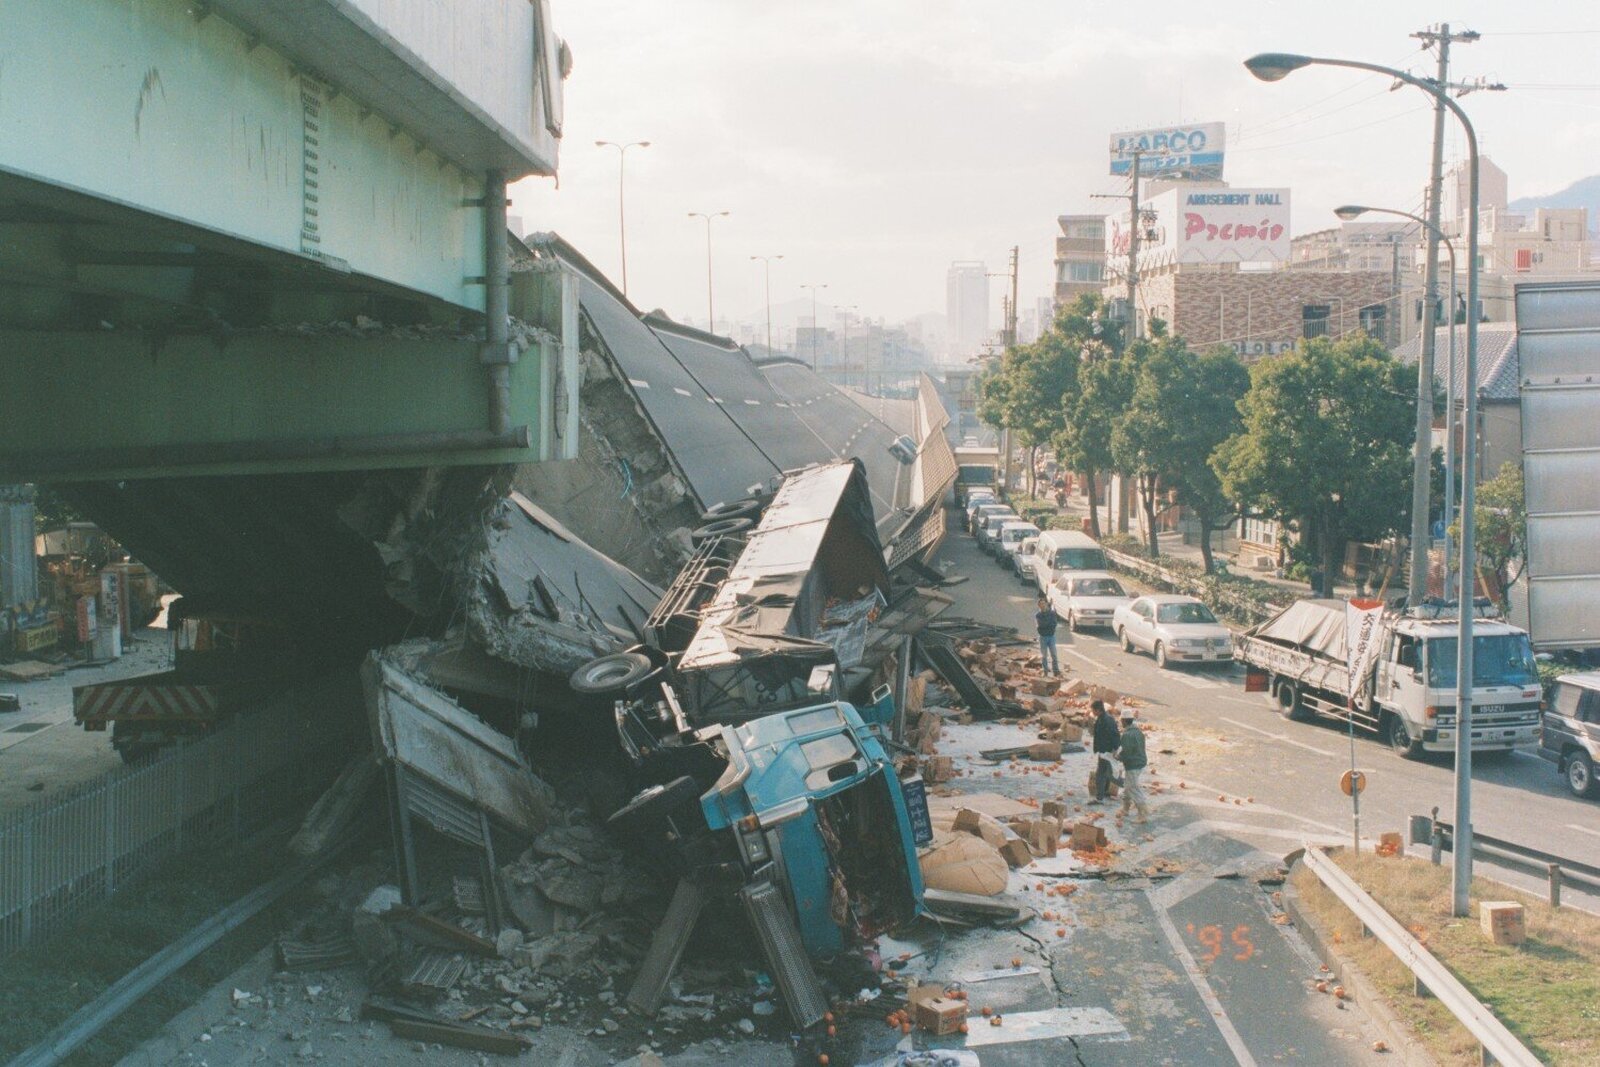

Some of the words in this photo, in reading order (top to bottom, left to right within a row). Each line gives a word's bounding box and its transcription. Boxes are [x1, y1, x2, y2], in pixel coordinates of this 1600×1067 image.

[1186, 194, 1250, 205] AMUSEMENT
[1255, 193, 1282, 205] HALL
[1184, 212, 1284, 241] Premio
[1480, 705, 1504, 713] ISUZU
